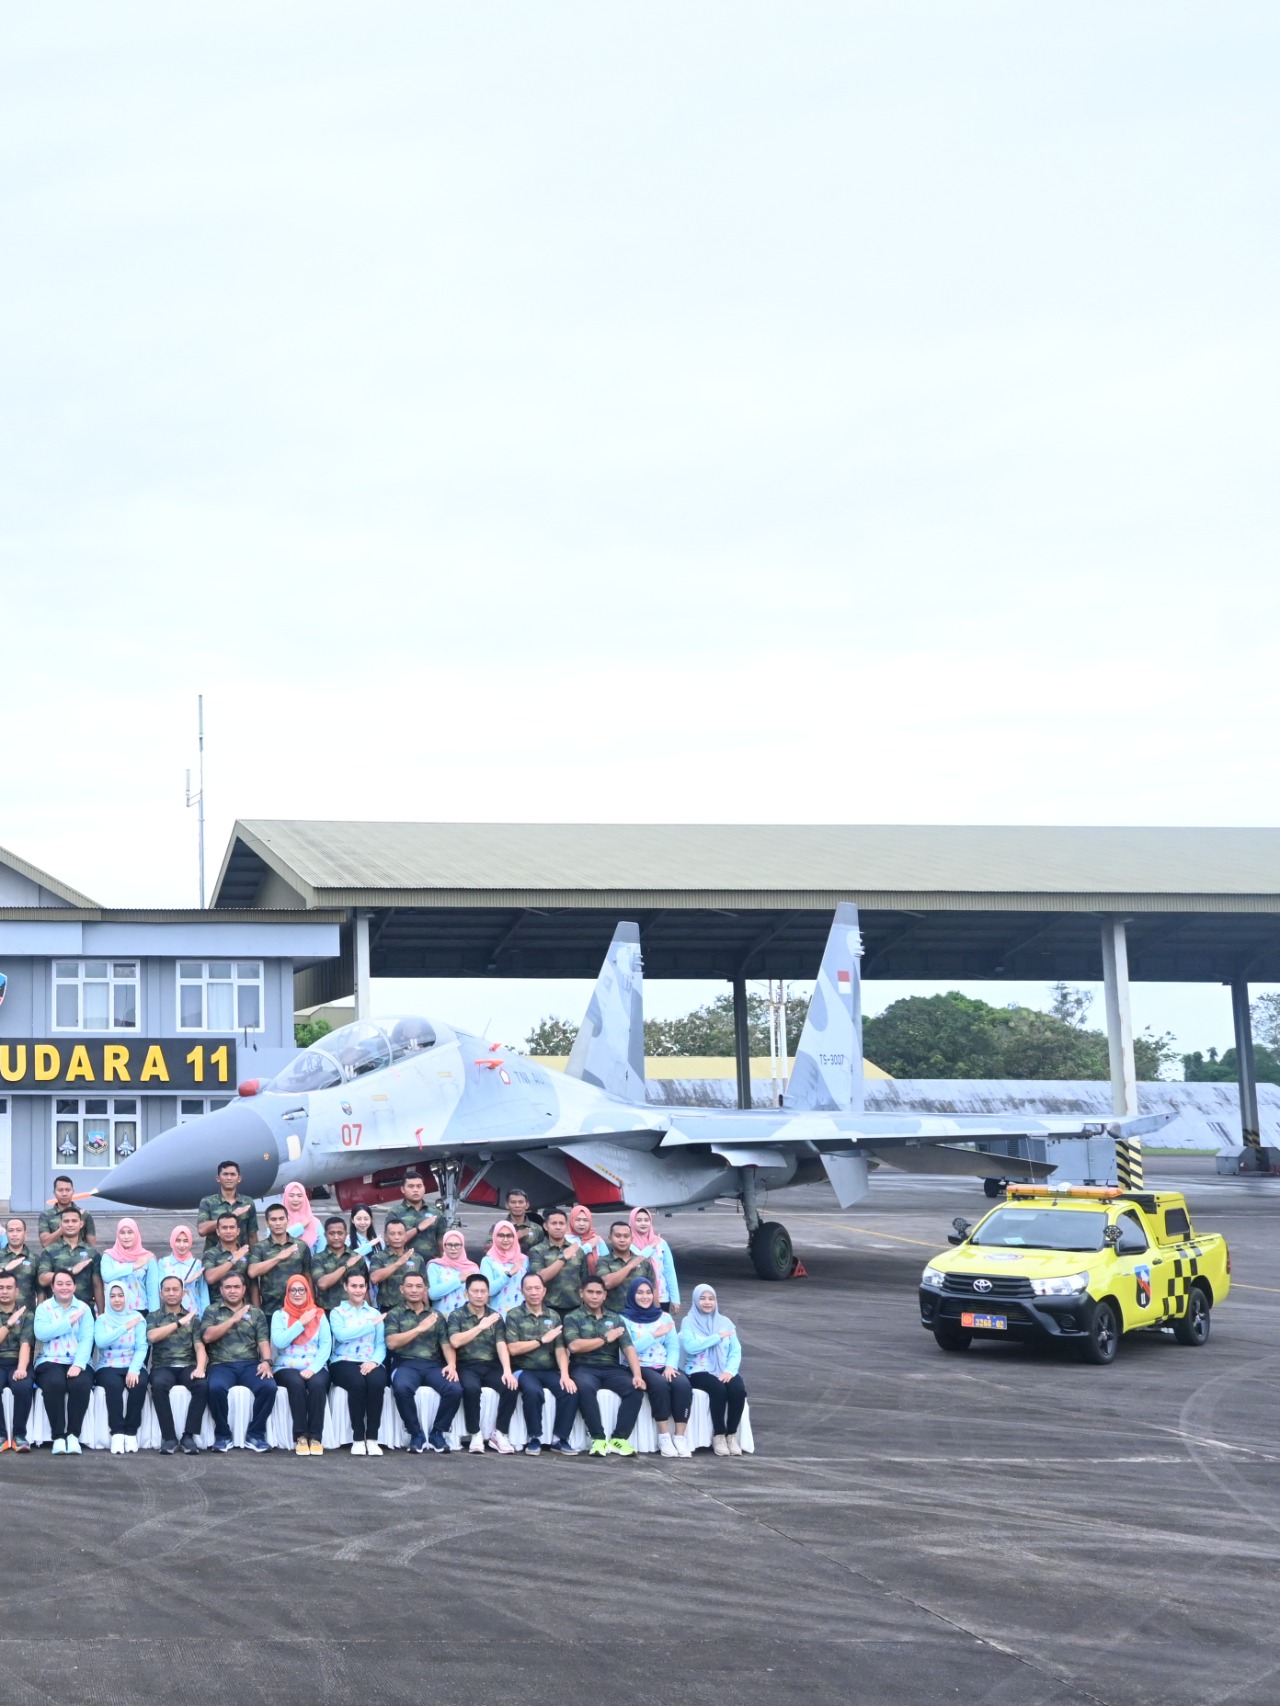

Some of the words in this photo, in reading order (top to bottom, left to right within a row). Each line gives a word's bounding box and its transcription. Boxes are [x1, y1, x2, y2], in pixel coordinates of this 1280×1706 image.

[0, 1044, 170, 1082] UDARA
[186, 1045, 229, 1082] 11
[819, 1054, 844, 1066] TS-3007
[513, 1070, 530, 1084] TNI
[341, 1123, 363, 1147] 07
